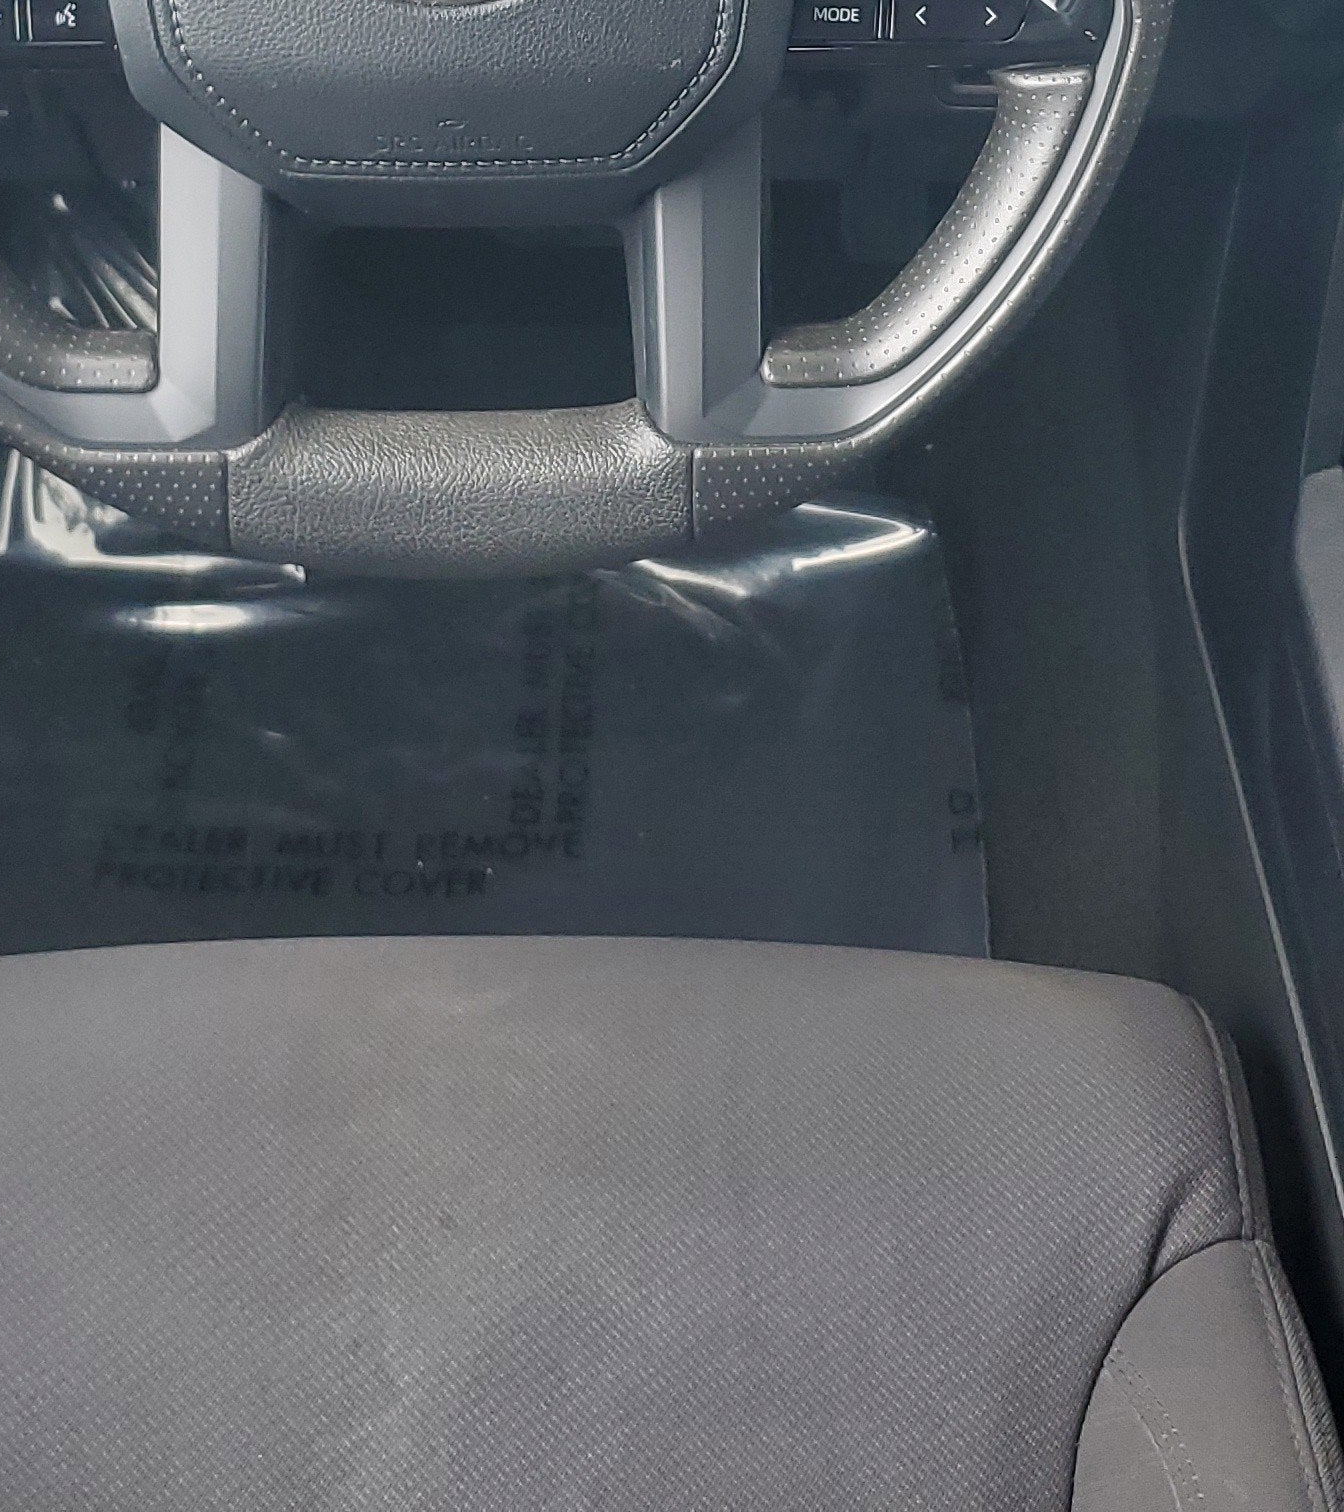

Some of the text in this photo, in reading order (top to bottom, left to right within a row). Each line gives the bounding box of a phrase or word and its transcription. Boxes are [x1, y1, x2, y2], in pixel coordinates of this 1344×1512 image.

[813, 7, 861, 23] MODE
[275, 831, 389, 860] MUST
[415, 831, 582, 860] REMOVE
[94, 858, 488, 899] PROTECTIVE COVER
